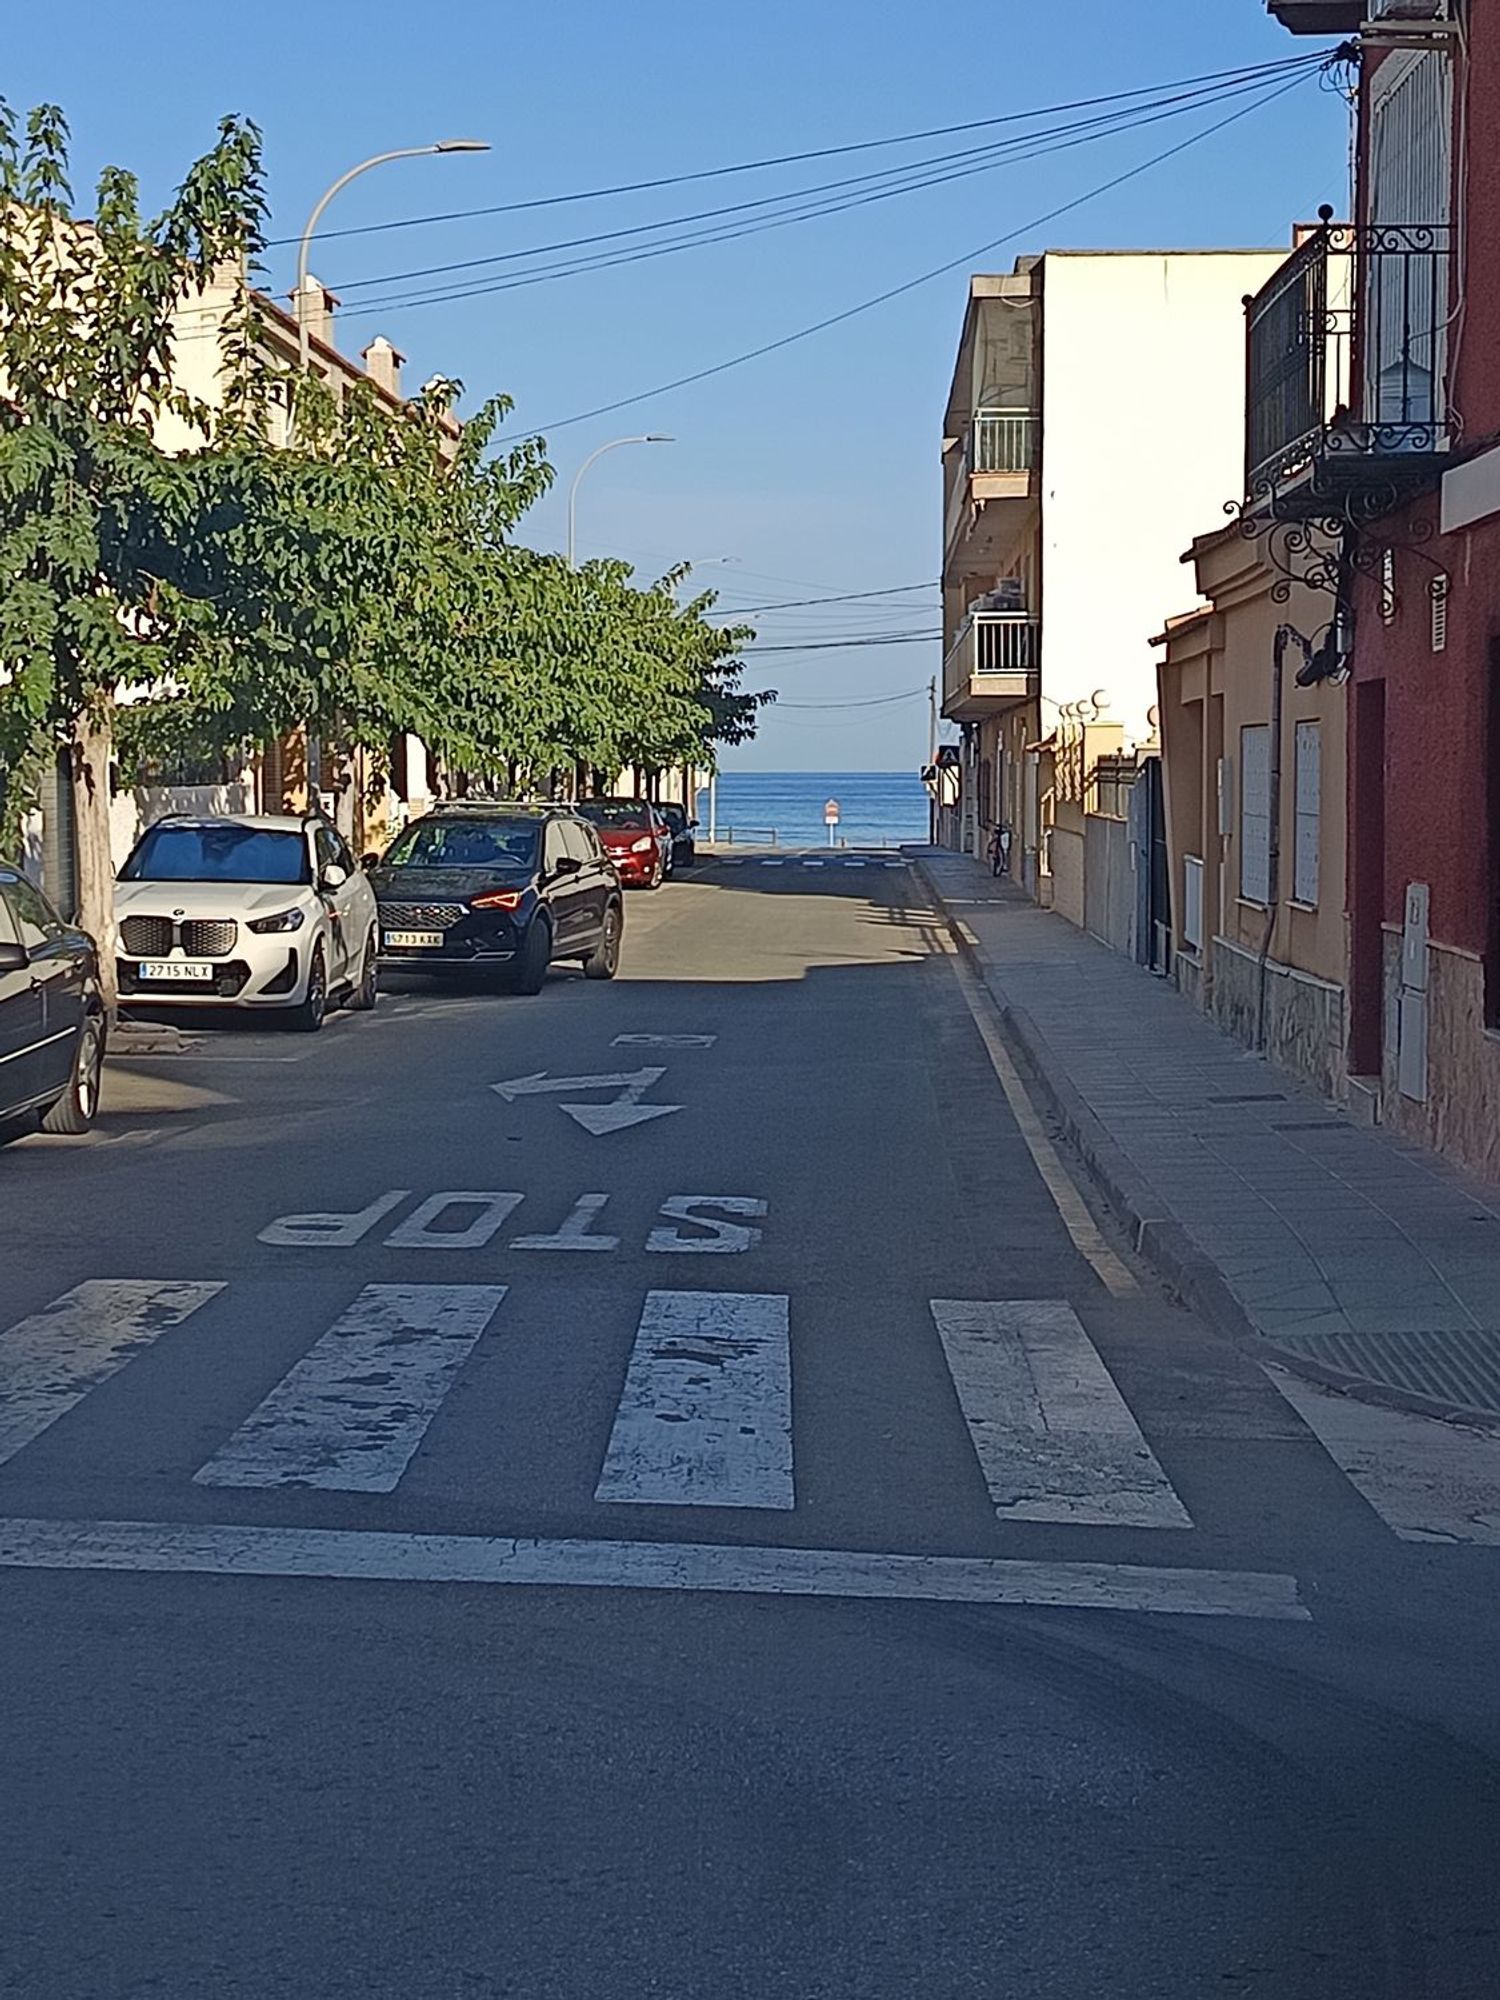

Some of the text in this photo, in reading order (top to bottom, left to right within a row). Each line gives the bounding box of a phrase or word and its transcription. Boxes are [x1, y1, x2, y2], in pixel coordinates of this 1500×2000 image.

[149, 965, 208, 977] 2715 NLX
[256, 1189, 769, 1253] STOP
